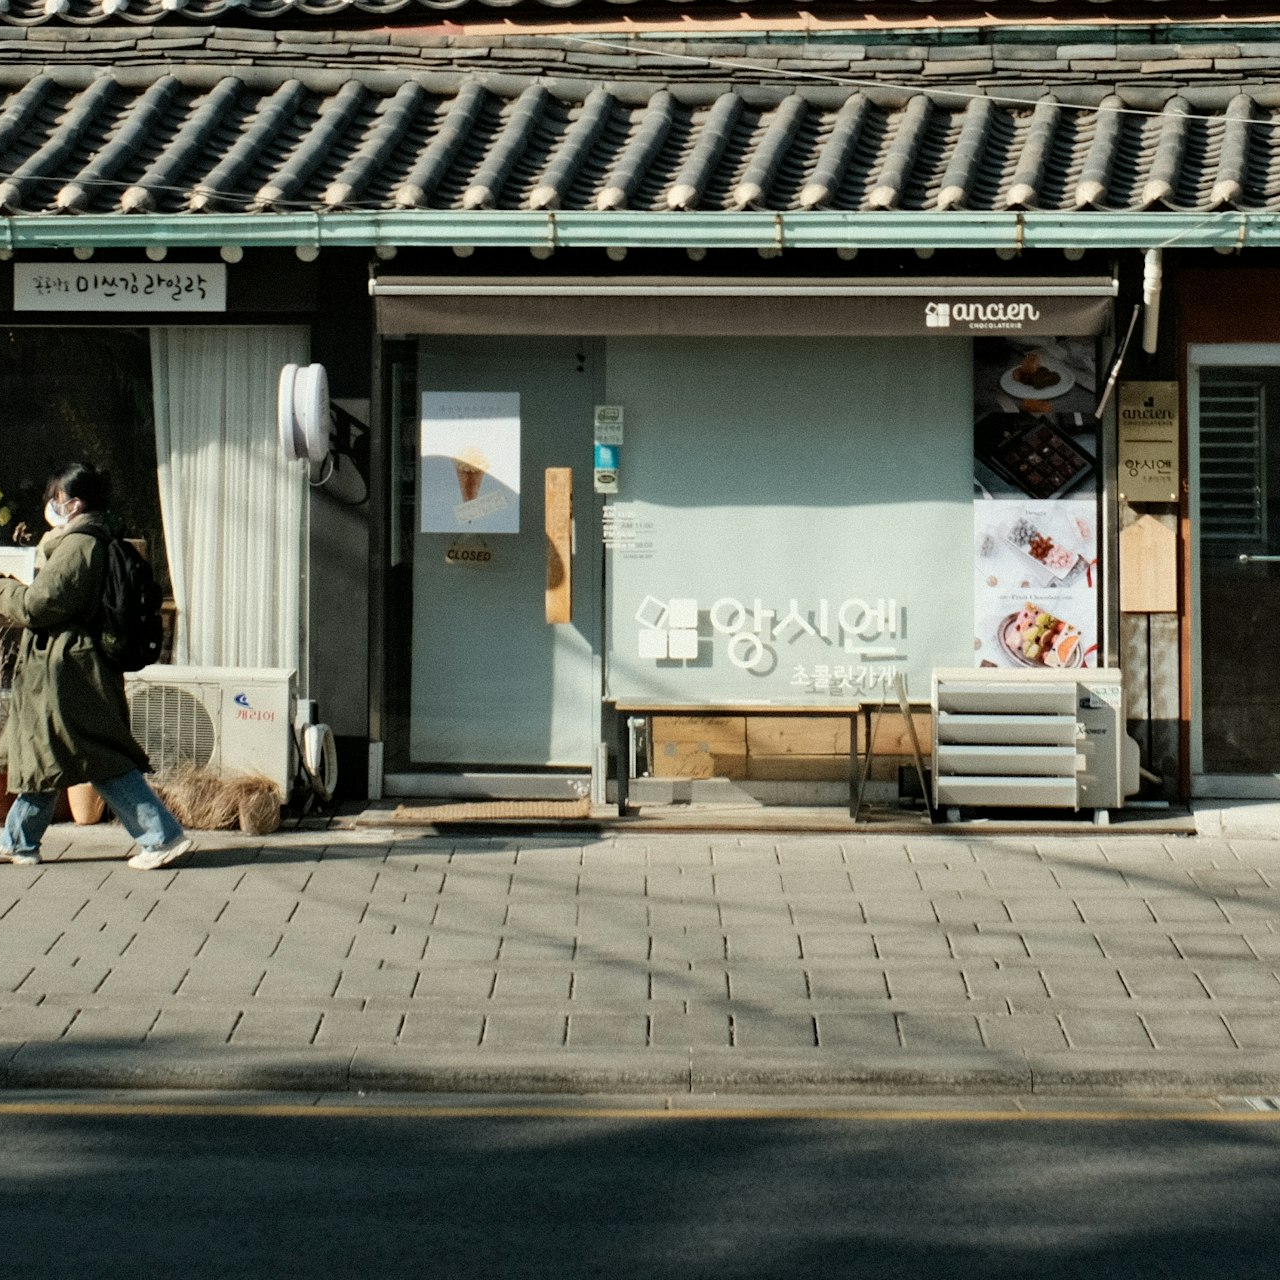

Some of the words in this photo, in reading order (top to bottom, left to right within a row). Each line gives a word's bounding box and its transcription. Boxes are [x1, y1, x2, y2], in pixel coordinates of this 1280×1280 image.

[952, 303, 1040, 321] ancien
[1122, 409, 1176, 420] ancien
[1124, 459, 1172, 477] 앙시엔
[447, 549, 492, 561] CLOSED
[710, 597, 897, 669] 앙시엔
